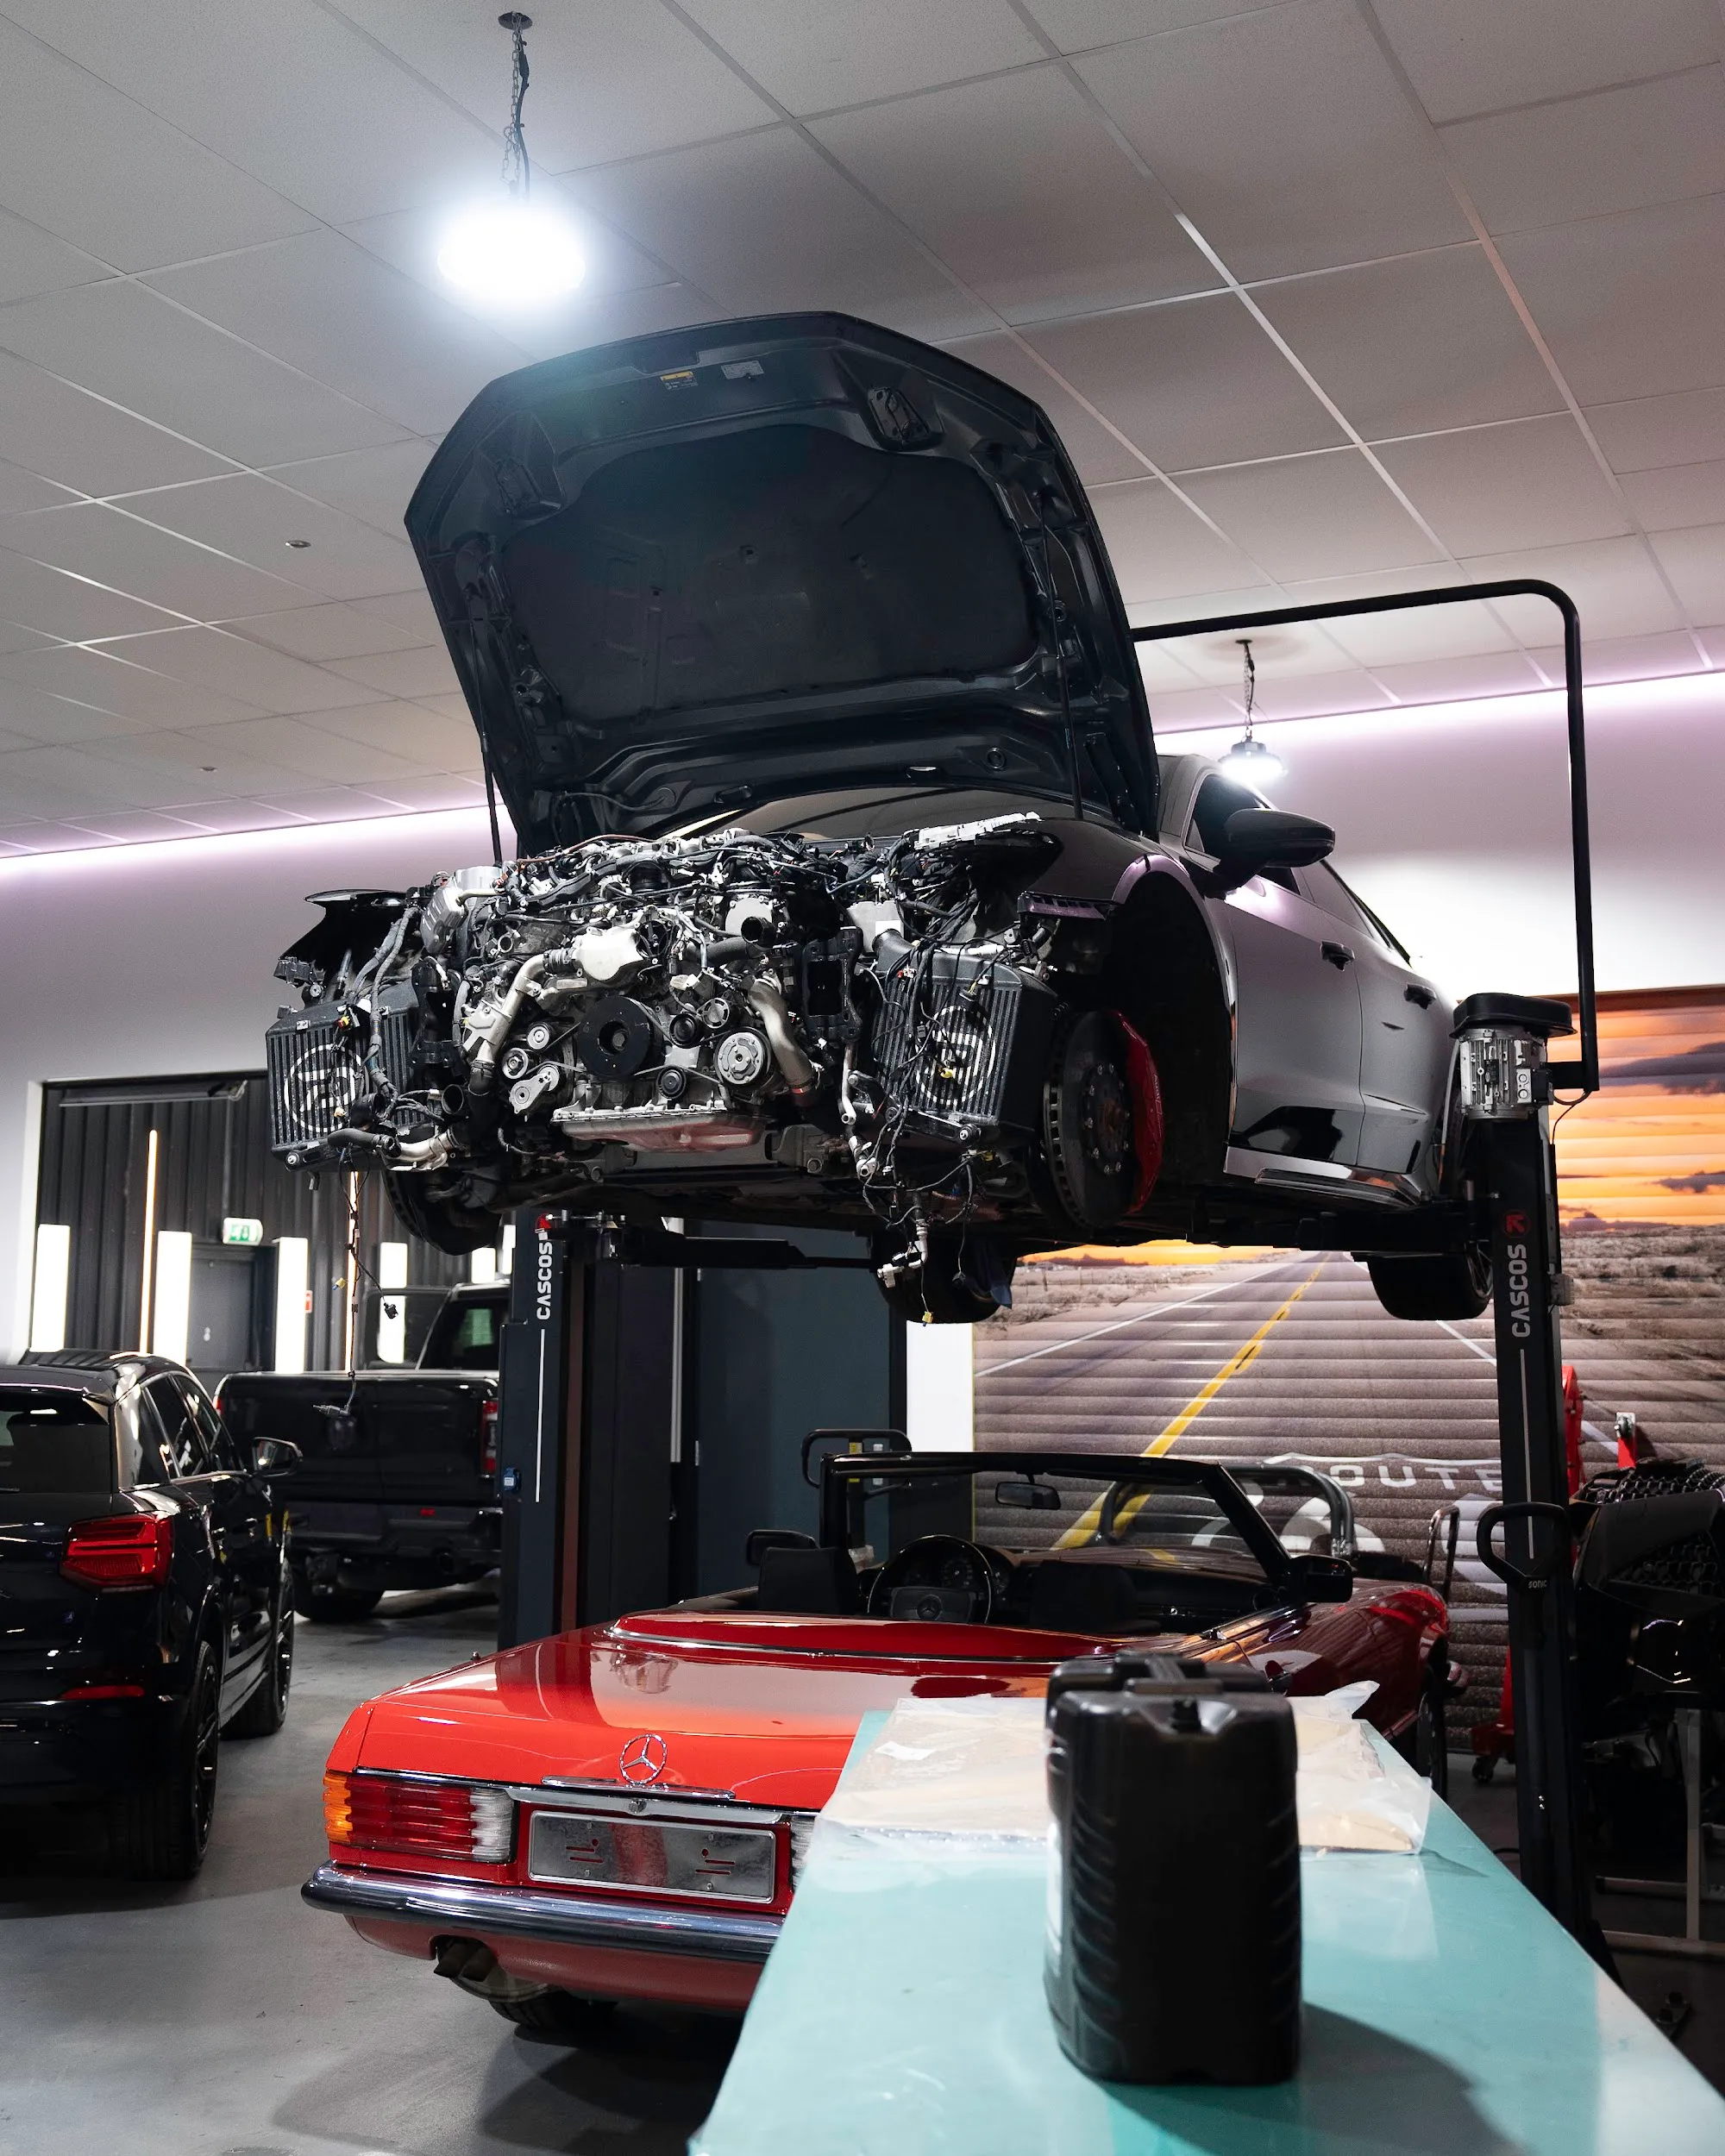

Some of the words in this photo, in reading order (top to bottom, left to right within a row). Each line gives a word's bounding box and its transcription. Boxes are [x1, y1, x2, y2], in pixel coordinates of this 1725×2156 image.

[536, 1242, 553, 1320] CASCOS
[1507, 1244, 1531, 1338] CASCOS
[1279, 1463, 1503, 1492] OUTE
